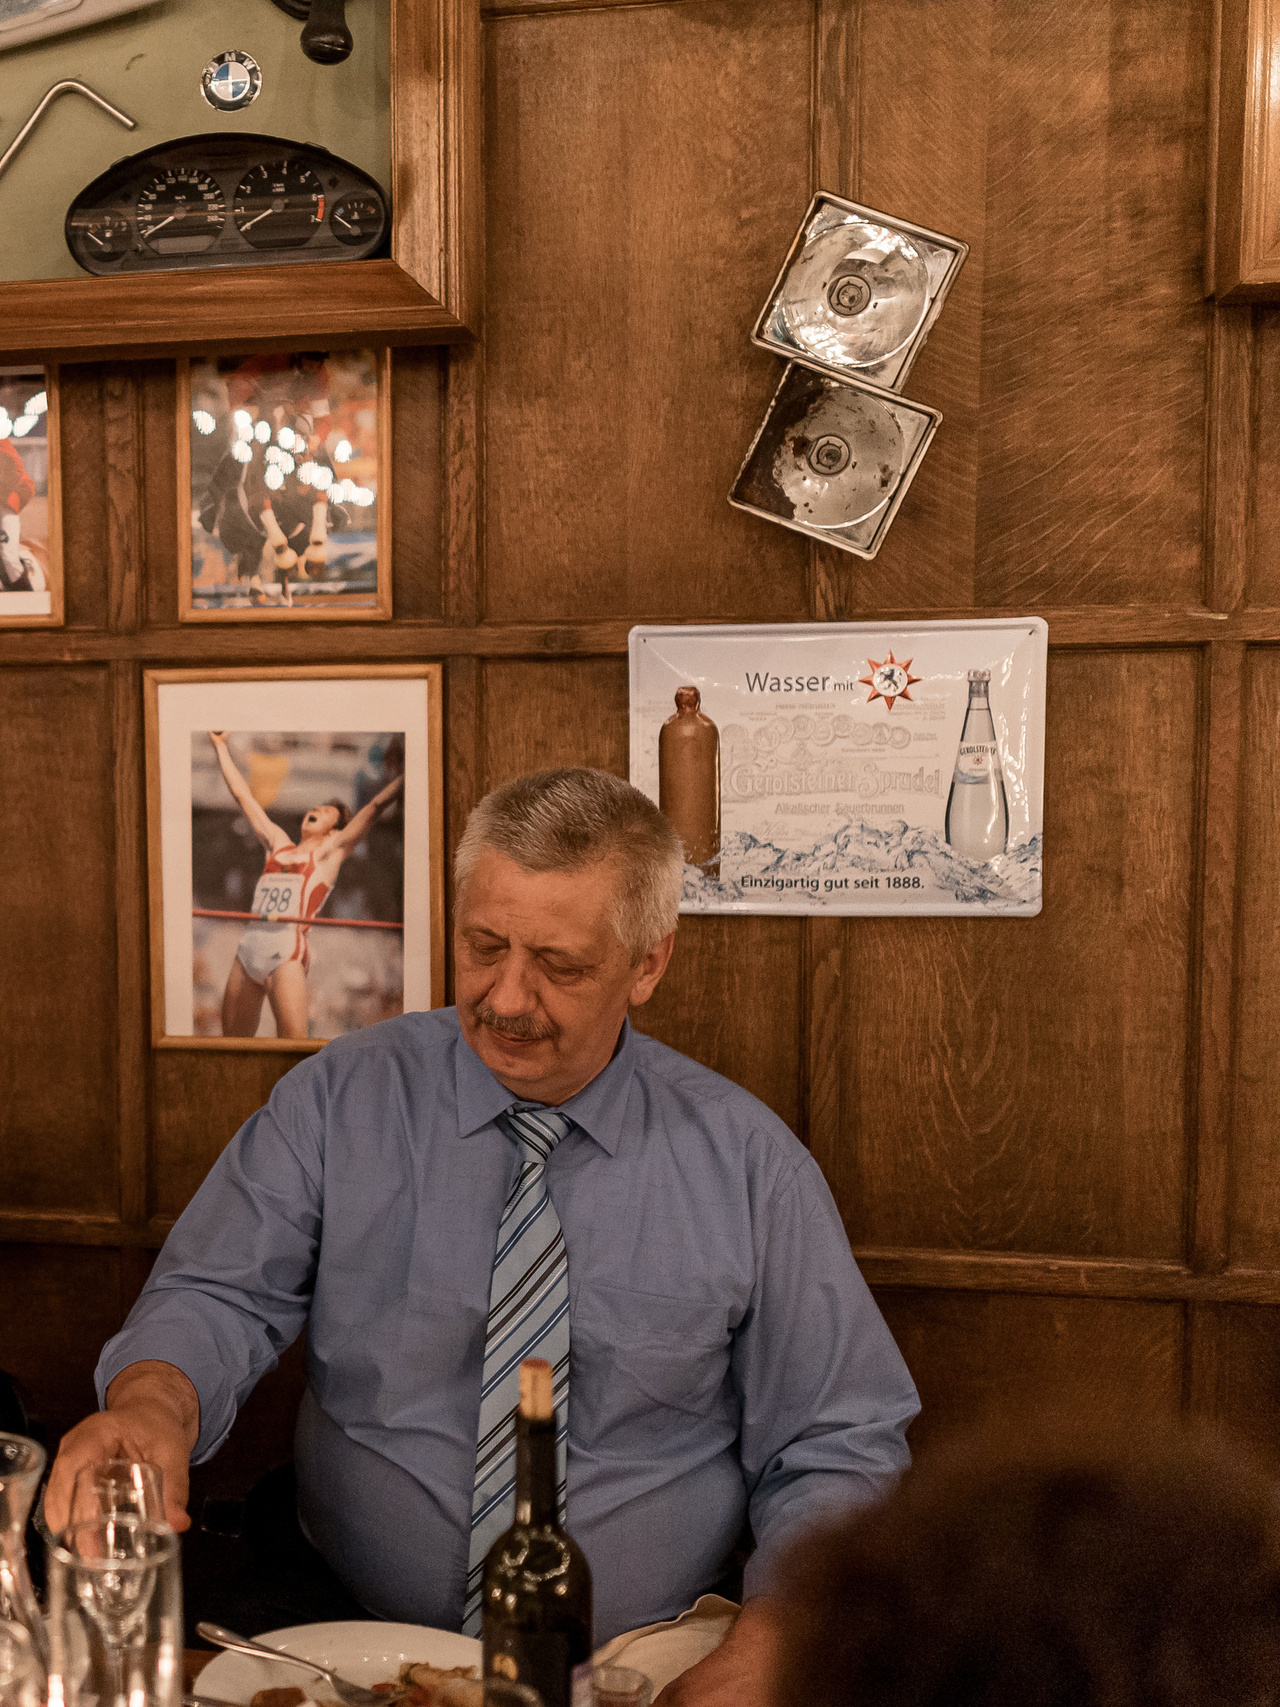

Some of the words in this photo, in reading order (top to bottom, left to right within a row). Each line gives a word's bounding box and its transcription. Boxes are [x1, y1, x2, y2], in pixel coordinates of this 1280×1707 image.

[745, 672, 830, 692] Wasser
[833, 681, 854, 691] mit
[729, 763, 856, 798] Gerolsteiner
[858, 763, 942, 799] Sprudel
[740, 875, 820, 892] Einzigartig
[823, 877, 849, 892] gut
[853, 876, 880, 889] seit
[885, 876, 925, 889] 1888.
[258, 887, 292, 913] 788
